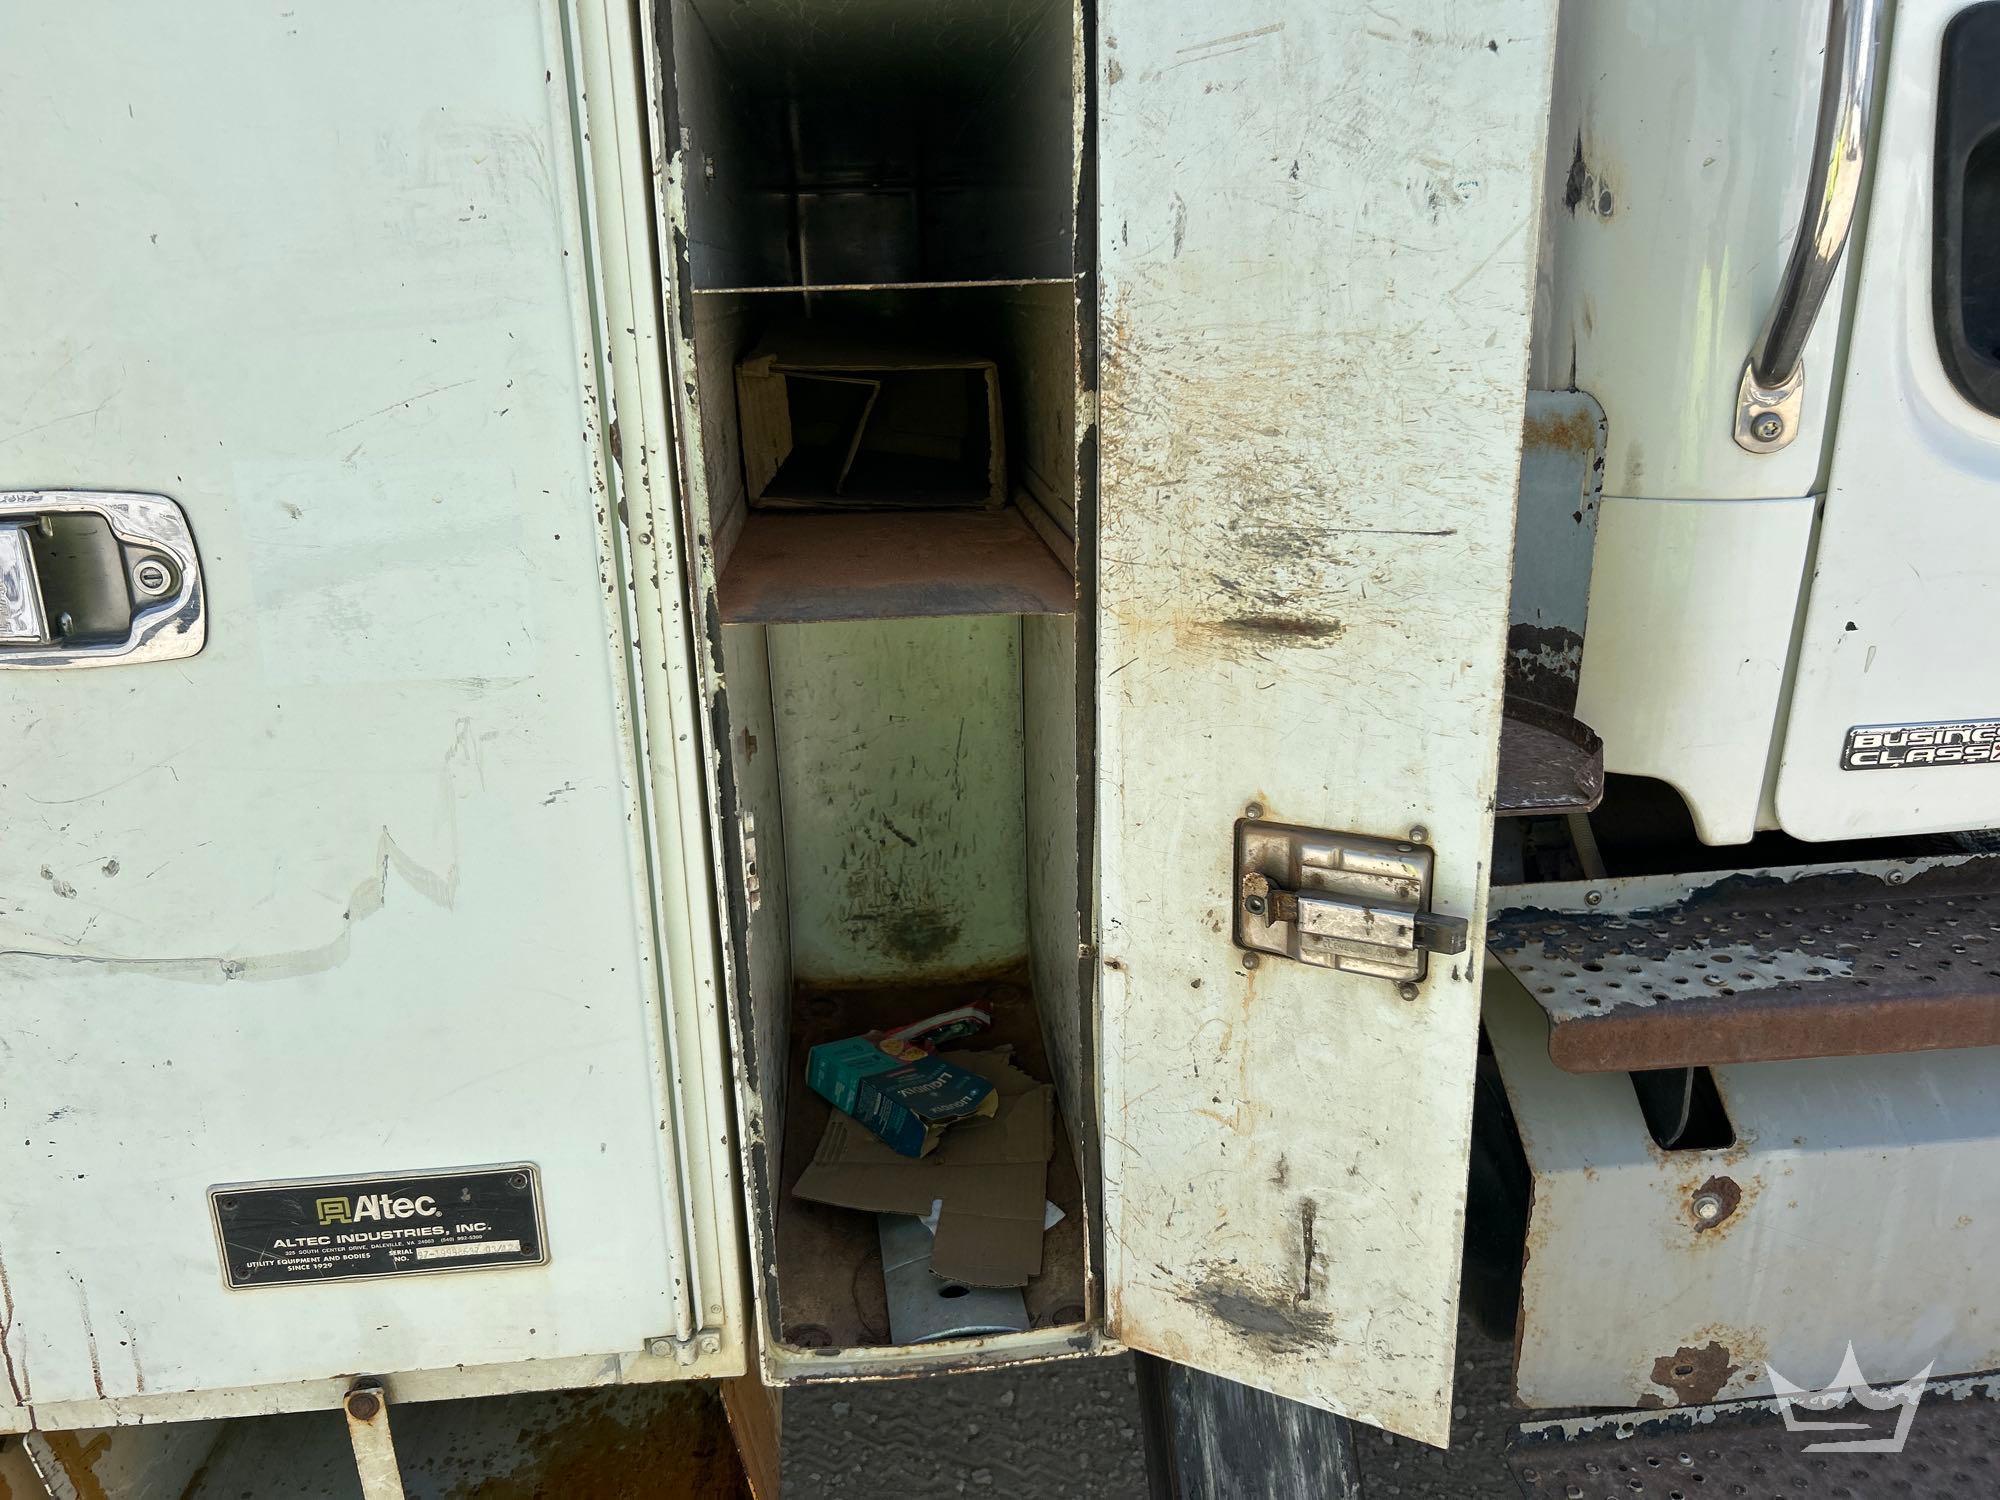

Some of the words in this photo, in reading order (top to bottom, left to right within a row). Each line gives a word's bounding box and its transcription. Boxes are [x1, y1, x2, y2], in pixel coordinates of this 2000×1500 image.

[1850, 744, 1990, 766] CLASS
[273, 1235, 331, 1249] ALTEC
[336, 1226, 450, 1244] INDUSTRIES,
[456, 1222, 492, 1234] INC.
[321, 1246, 346, 1254] CENTER
[246, 1259, 275, 1268] UTILITY
[277, 1256, 321, 1265] EQUIPMENT
[343, 1252, 371, 1261] BODIES
[287, 1264, 311, 1272] SINCE
[312, 1262, 333, 1270] 1929
